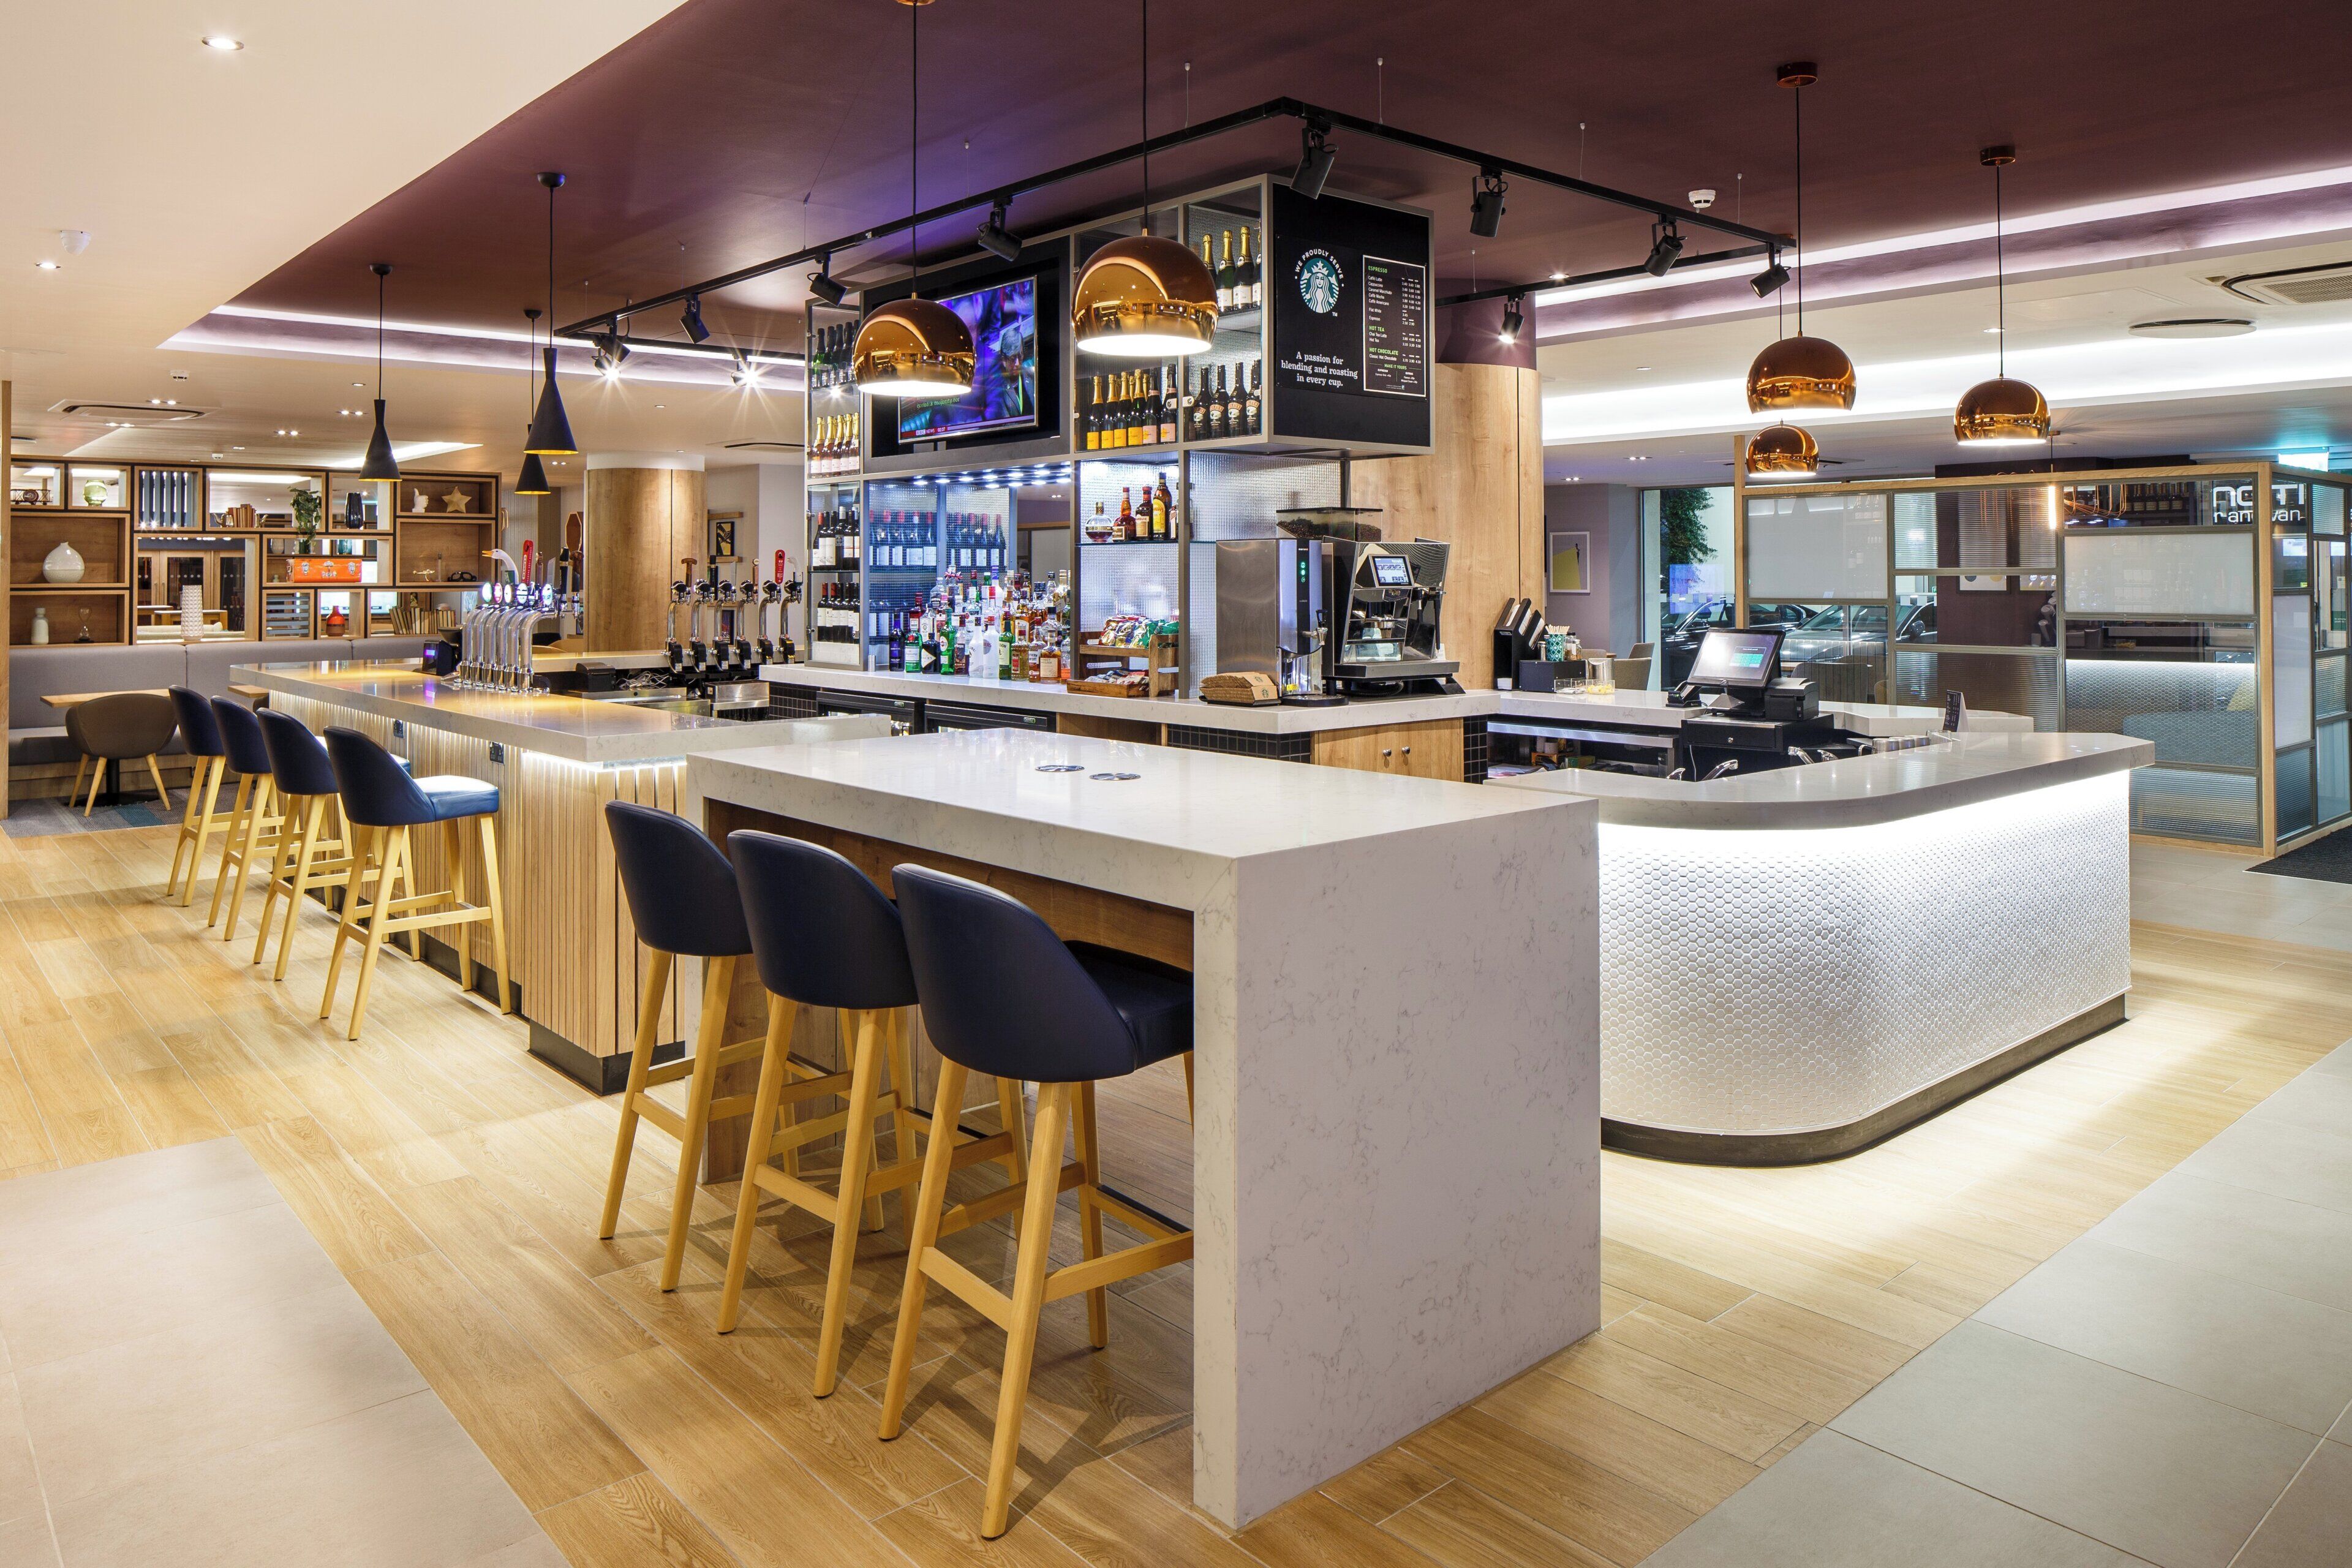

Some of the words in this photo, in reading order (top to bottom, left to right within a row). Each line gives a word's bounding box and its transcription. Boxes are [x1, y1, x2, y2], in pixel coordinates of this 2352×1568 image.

[1295, 260, 1303, 273] WE
[1302, 249, 1329, 261] PROUDLY
[1329, 255, 1344, 279] SERVE
[1368, 265, 1388, 274] ESPRESSO
[1295, 351, 1302, 360] A
[1304, 354, 1330, 363] passion
[1333, 356, 1343, 365] for
[1281, 360, 1313, 374] blending
[1329, 368, 1358, 380] roasting
[1296, 373, 1304, 382] in
[1306, 376, 1327, 386] every
[1329, 379, 1343, 388] cup.
